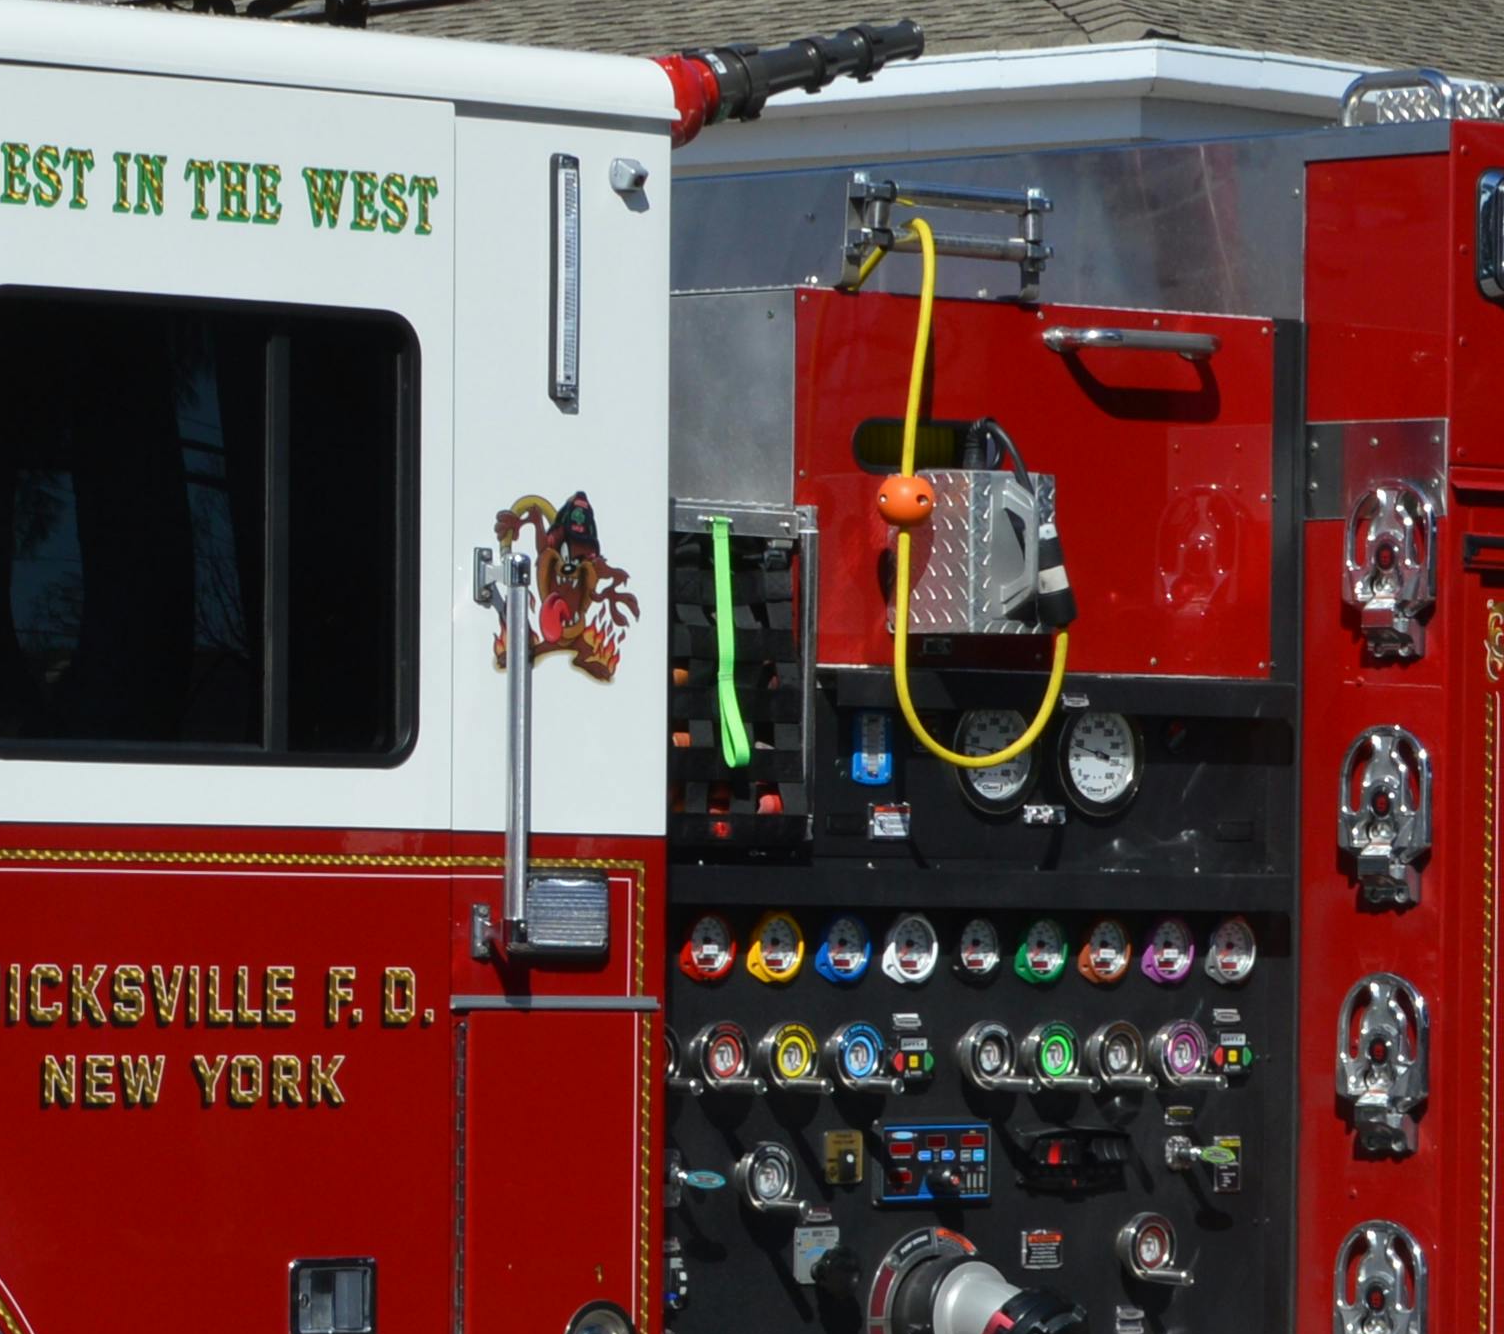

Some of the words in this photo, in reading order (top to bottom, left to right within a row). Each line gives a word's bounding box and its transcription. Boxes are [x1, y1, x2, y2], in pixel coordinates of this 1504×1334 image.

[111, 151, 168, 215] IN
[184, 157, 283, 225] THE
[302, 166, 439, 236] WEST
[327, 966, 363, 1024] F.
[384, 967, 435, 1024] D.
[43, 1055, 165, 1105] NEW
[193, 1055, 345, 1105] YORK
